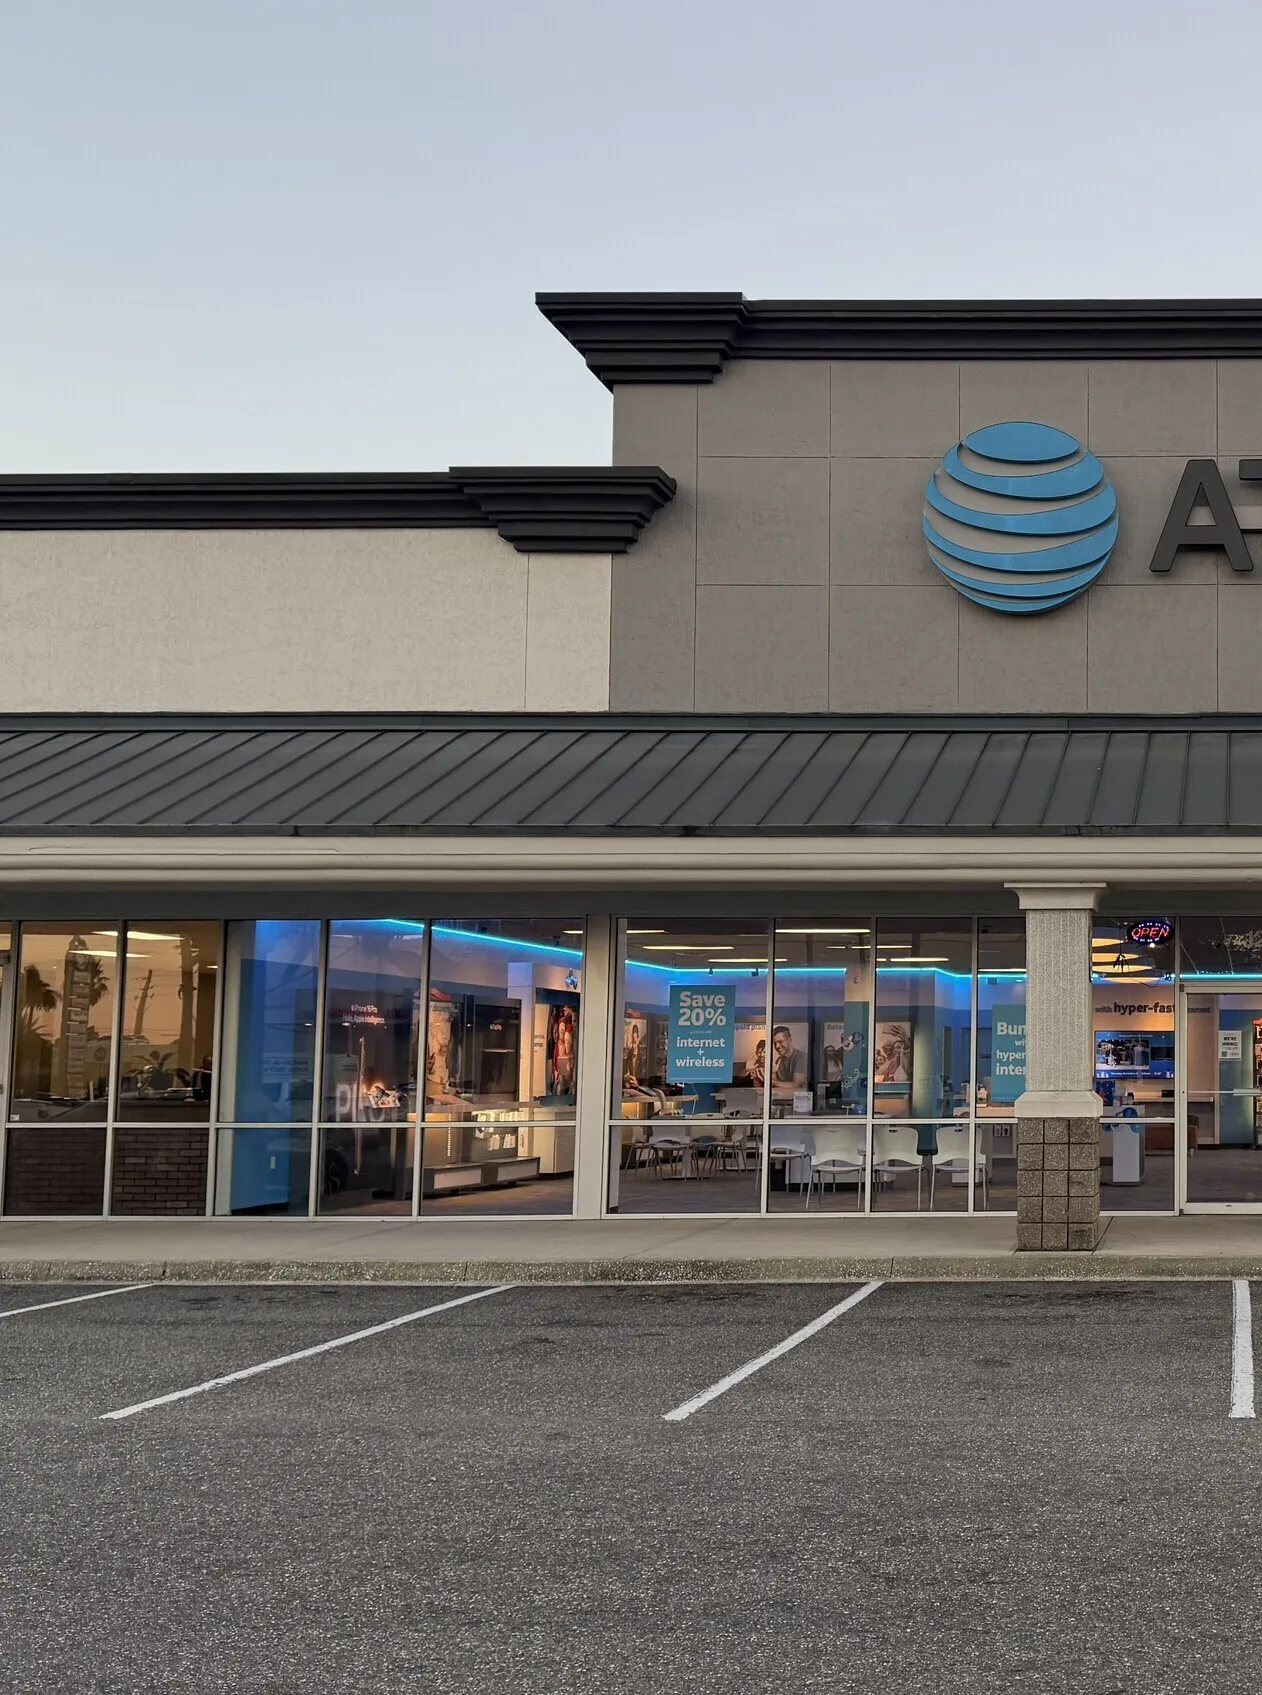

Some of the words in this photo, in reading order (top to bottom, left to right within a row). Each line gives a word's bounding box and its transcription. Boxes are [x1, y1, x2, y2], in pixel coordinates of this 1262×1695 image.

[1131, 927, 1169, 939] OPEN
[679, 991, 726, 1007] Save
[1095, 1004, 1112, 1013] with
[678, 1008, 727, 1026] 20%
[750, 1023, 766, 1031] plan
[996, 1022, 1026, 1036] Bun
[676, 1036, 726, 1048] internet
[1015, 1039, 1026, 1047] wi
[675, 1056, 725, 1067] wireless
[996, 1050, 1026, 1062] hyper
[996, 1063, 1026, 1076] inter
